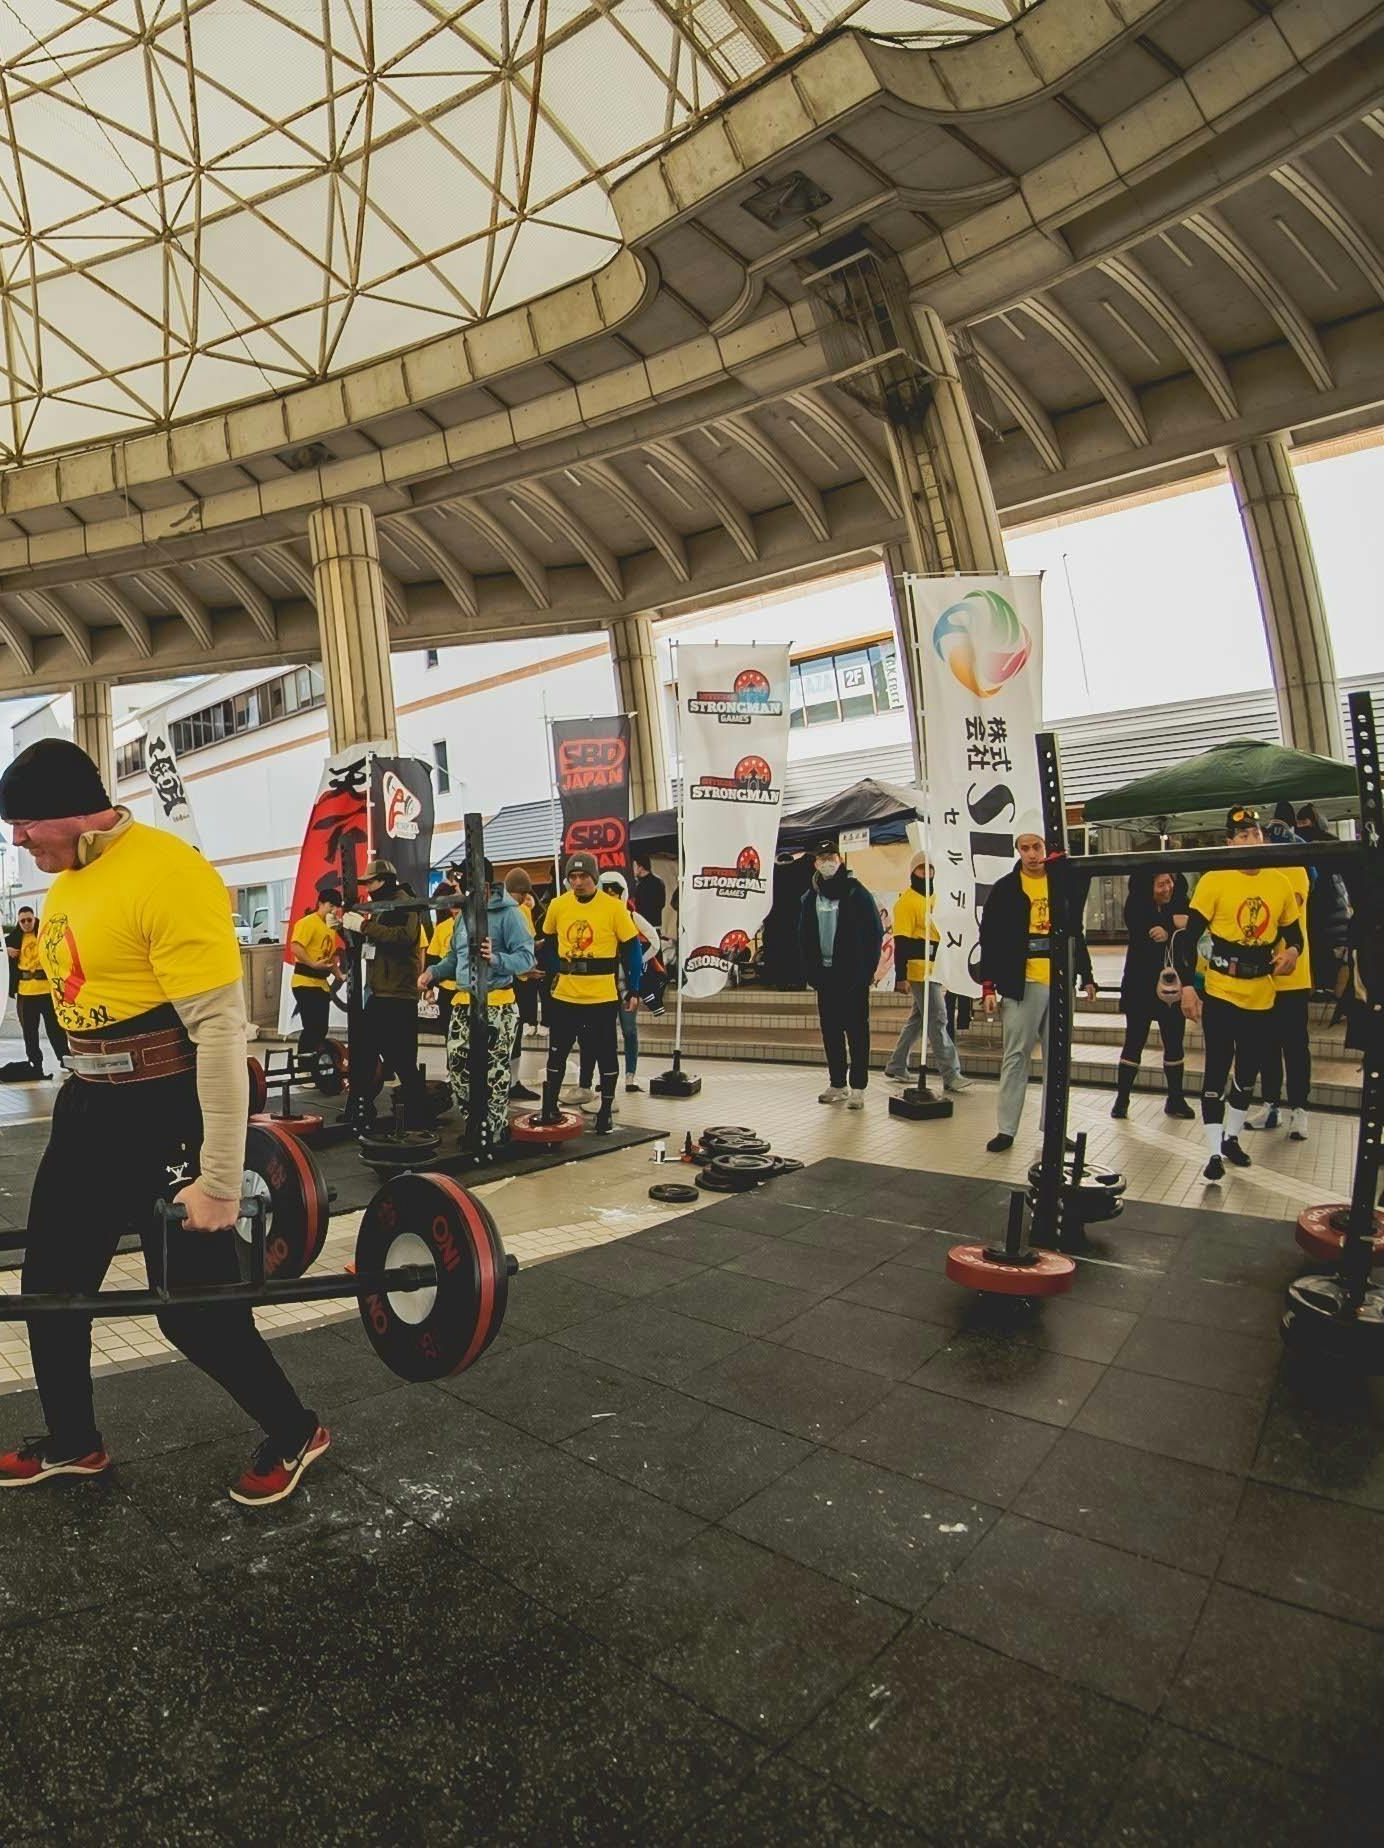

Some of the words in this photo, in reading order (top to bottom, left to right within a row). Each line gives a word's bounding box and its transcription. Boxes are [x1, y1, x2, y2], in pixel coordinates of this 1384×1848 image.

[845, 669, 863, 687] 2F
[690, 700, 782, 715] STRONGMAN
[720, 714, 750, 723] GAMES
[564, 742, 619, 769] SBD
[562, 767, 624, 790] JAPAN
[692, 786, 780, 804] STRONGMAN
[569, 823, 621, 849] SBD
[944, 808, 966, 949] セルデス
[718, 888, 746, 898] GAMES
